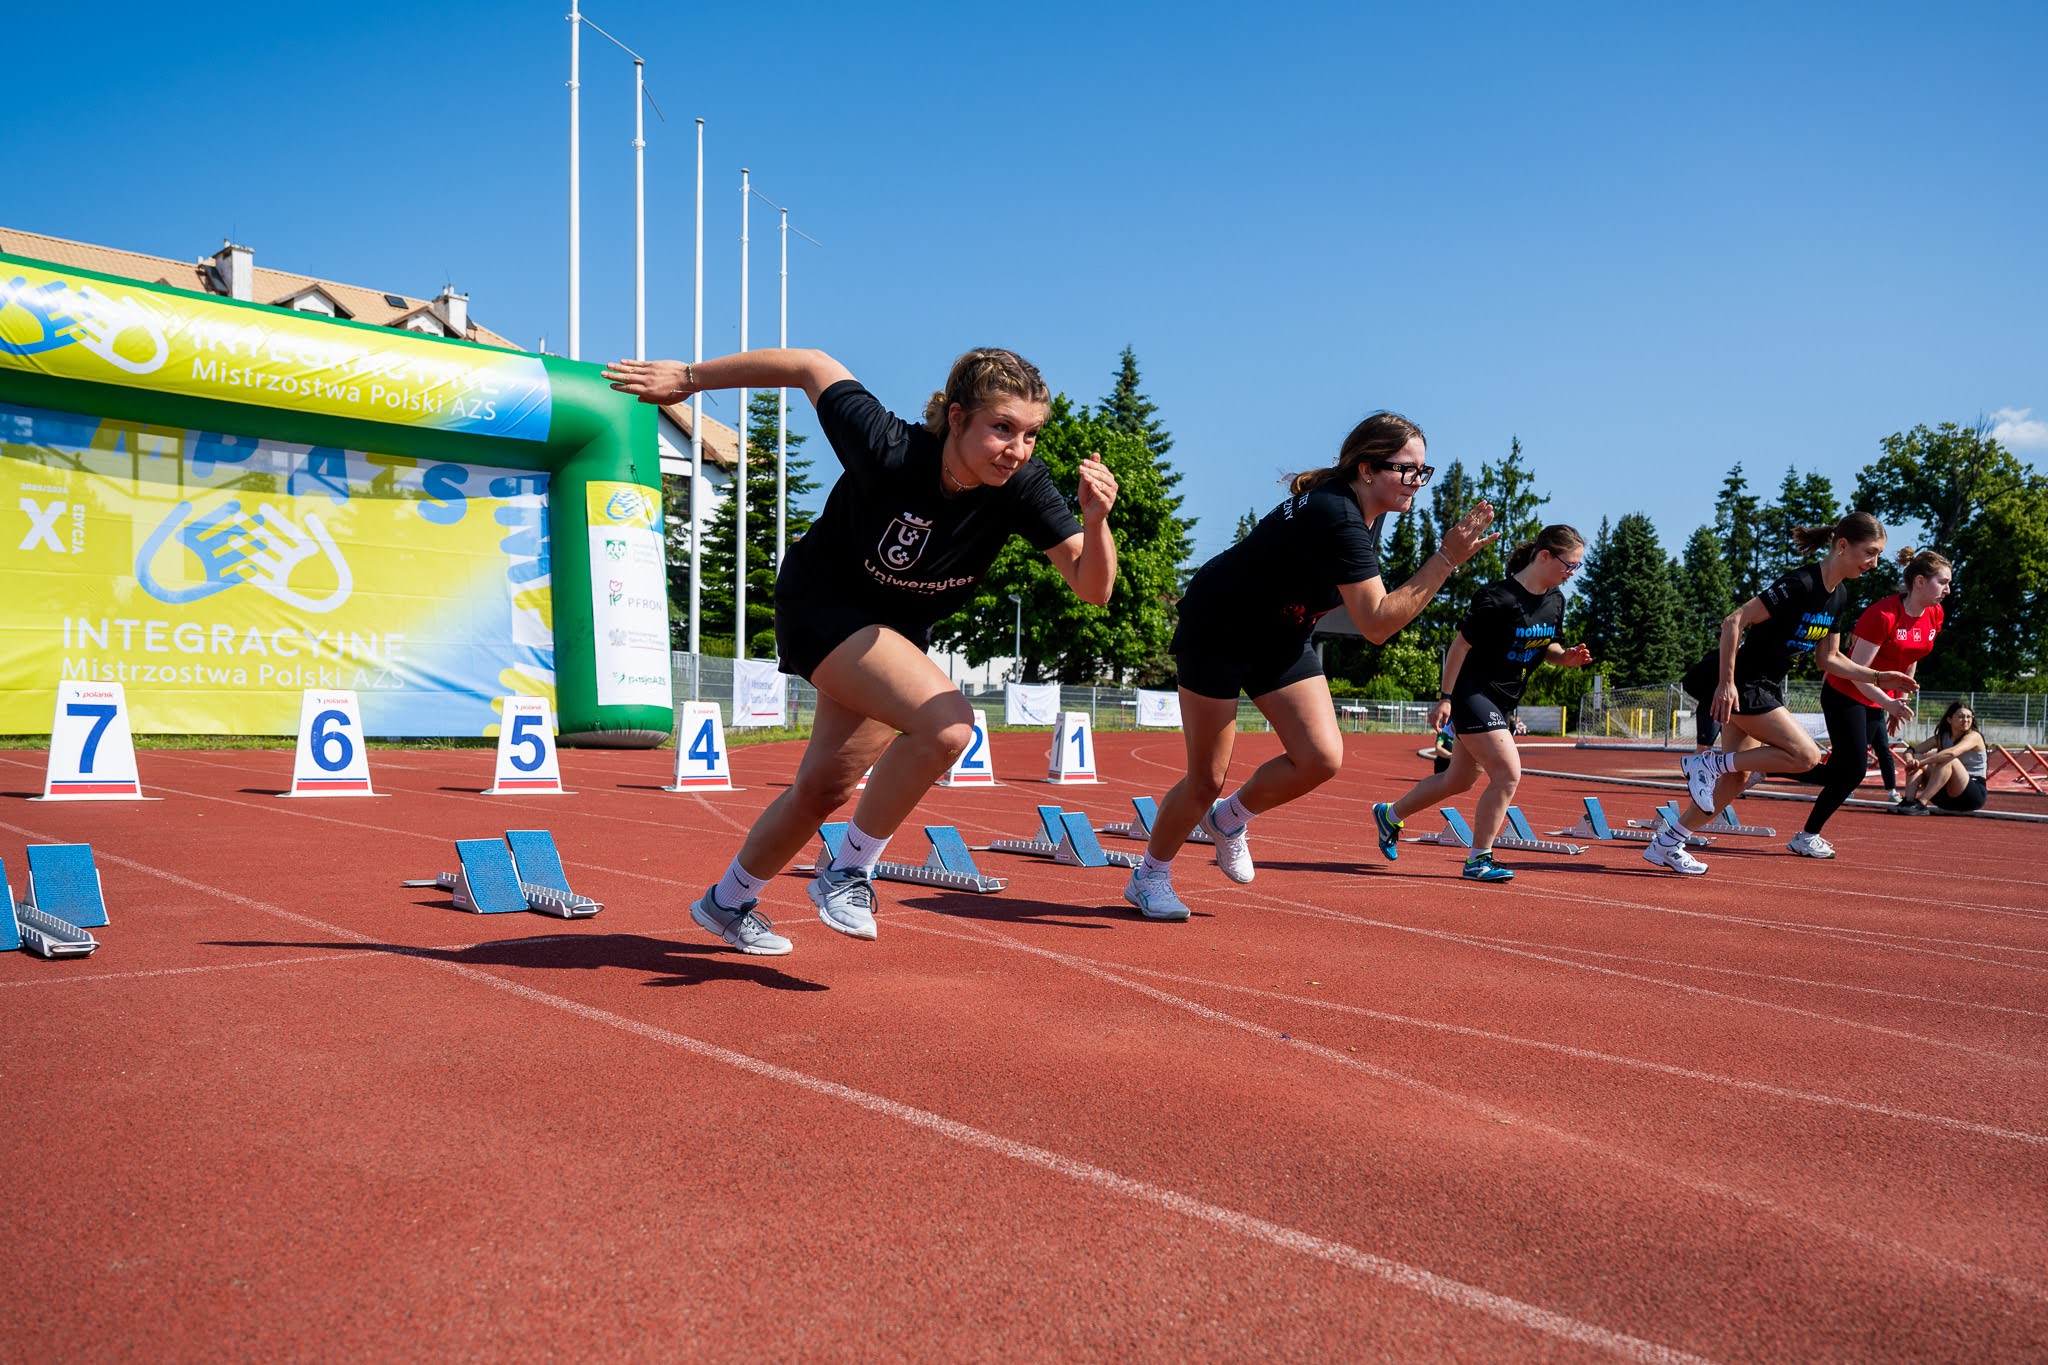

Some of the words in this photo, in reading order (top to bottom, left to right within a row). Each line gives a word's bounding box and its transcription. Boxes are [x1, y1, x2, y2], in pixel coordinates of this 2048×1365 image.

[192, 358, 361, 402] Mistrzostwa
[370, 385, 443, 413] Polski
[451, 397, 496, 421] AZS
[18, 498, 67, 552] X
[71, 504, 85, 554] EDYCJA
[864, 559, 974, 591] Uniwersytet
[628, 597, 662, 611] PFRON
[63, 617, 405, 661] INTEGRACYJNE
[62, 657, 247, 685] Mistrzostwa
[259, 663, 341, 687] Polski
[352, 667, 405, 689] AZS
[67, 703, 117, 773] 7
[311, 709, 354, 772] 6
[510, 715, 546, 771] 5
[688, 719, 720, 770] 4
[961, 725, 984, 768] 2
[1071, 726, 1085, 767] 1
